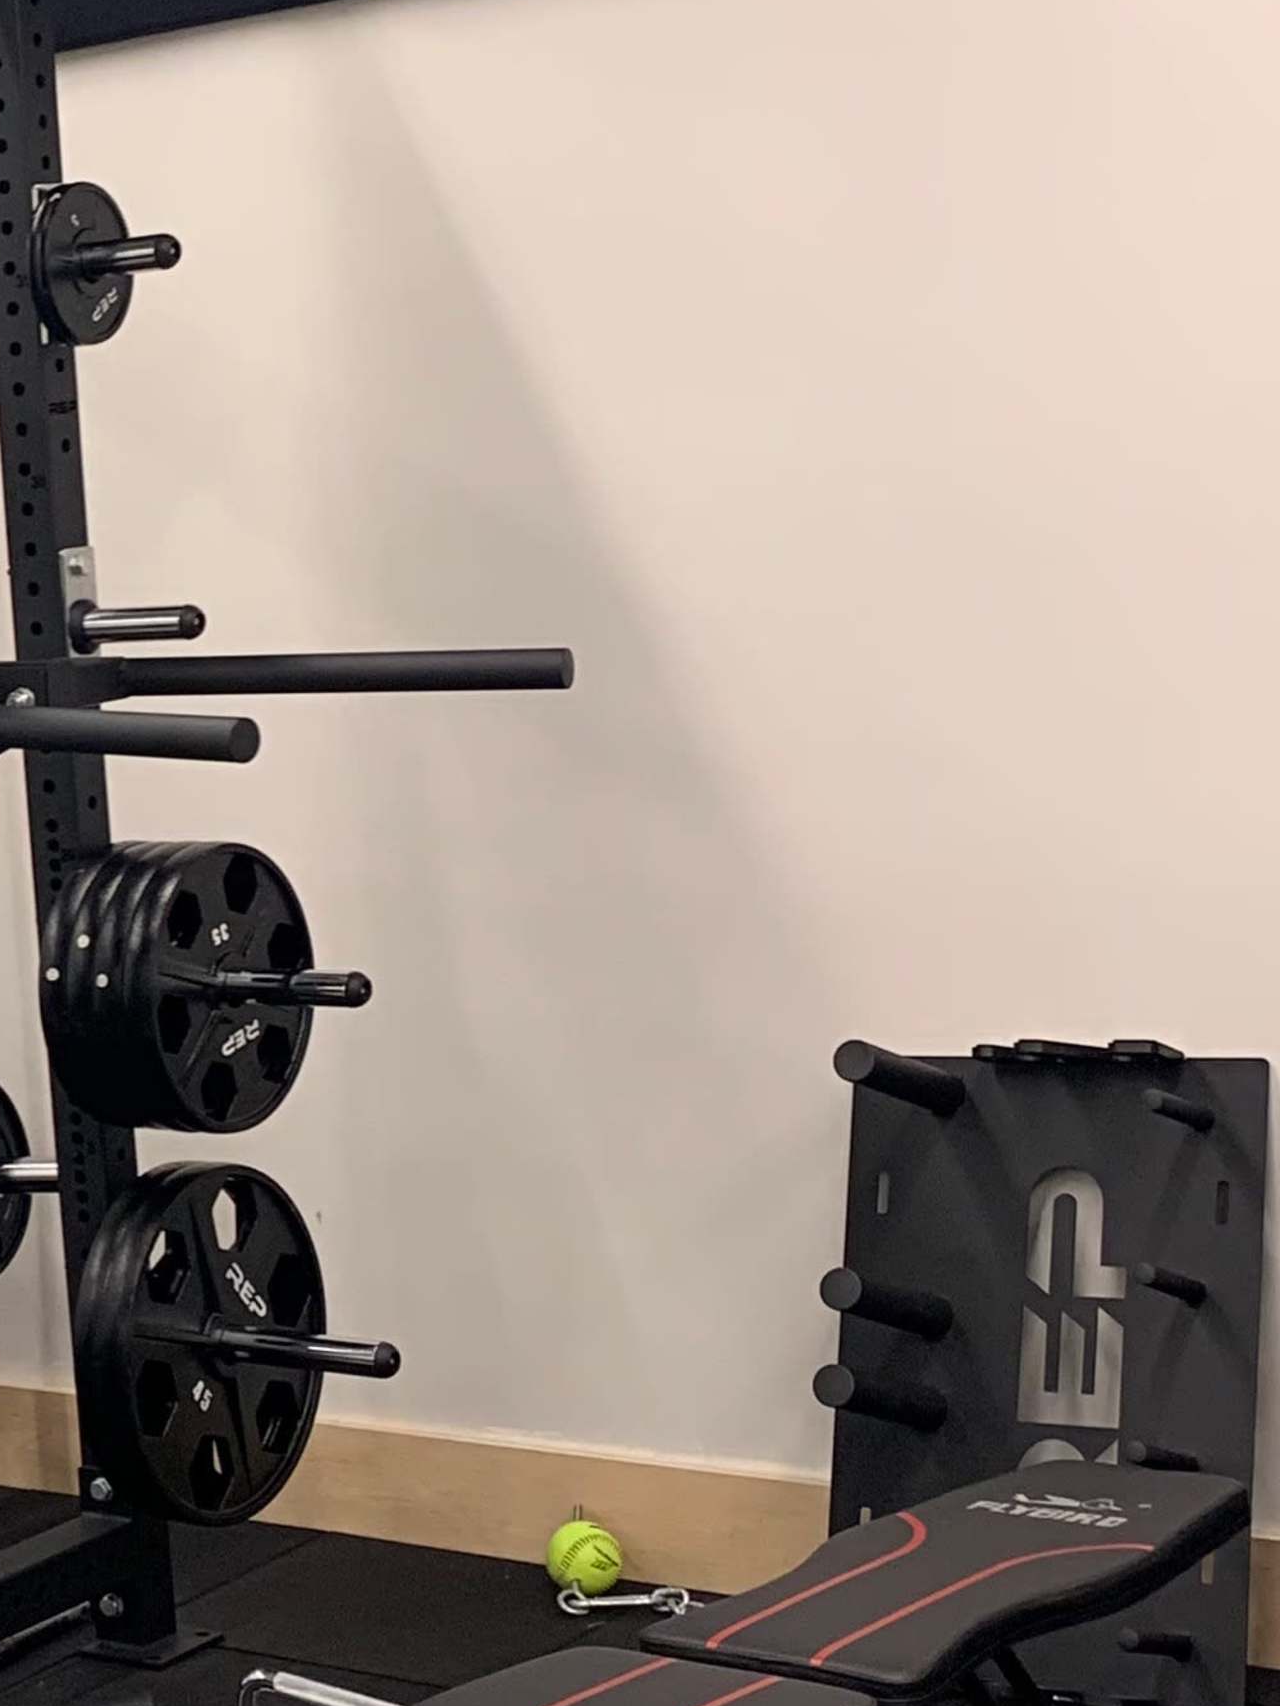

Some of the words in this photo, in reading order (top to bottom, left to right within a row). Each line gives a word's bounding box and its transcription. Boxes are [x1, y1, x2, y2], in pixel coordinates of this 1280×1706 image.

[91, 286, 119, 322] REP
[210, 922, 230, 947] 35
[221, 1018, 260, 1057] REP
[225, 1262, 268, 1318] REP
[192, 1379, 213, 1413] 45
[966, 1500, 1128, 1529] FLYBIRD
